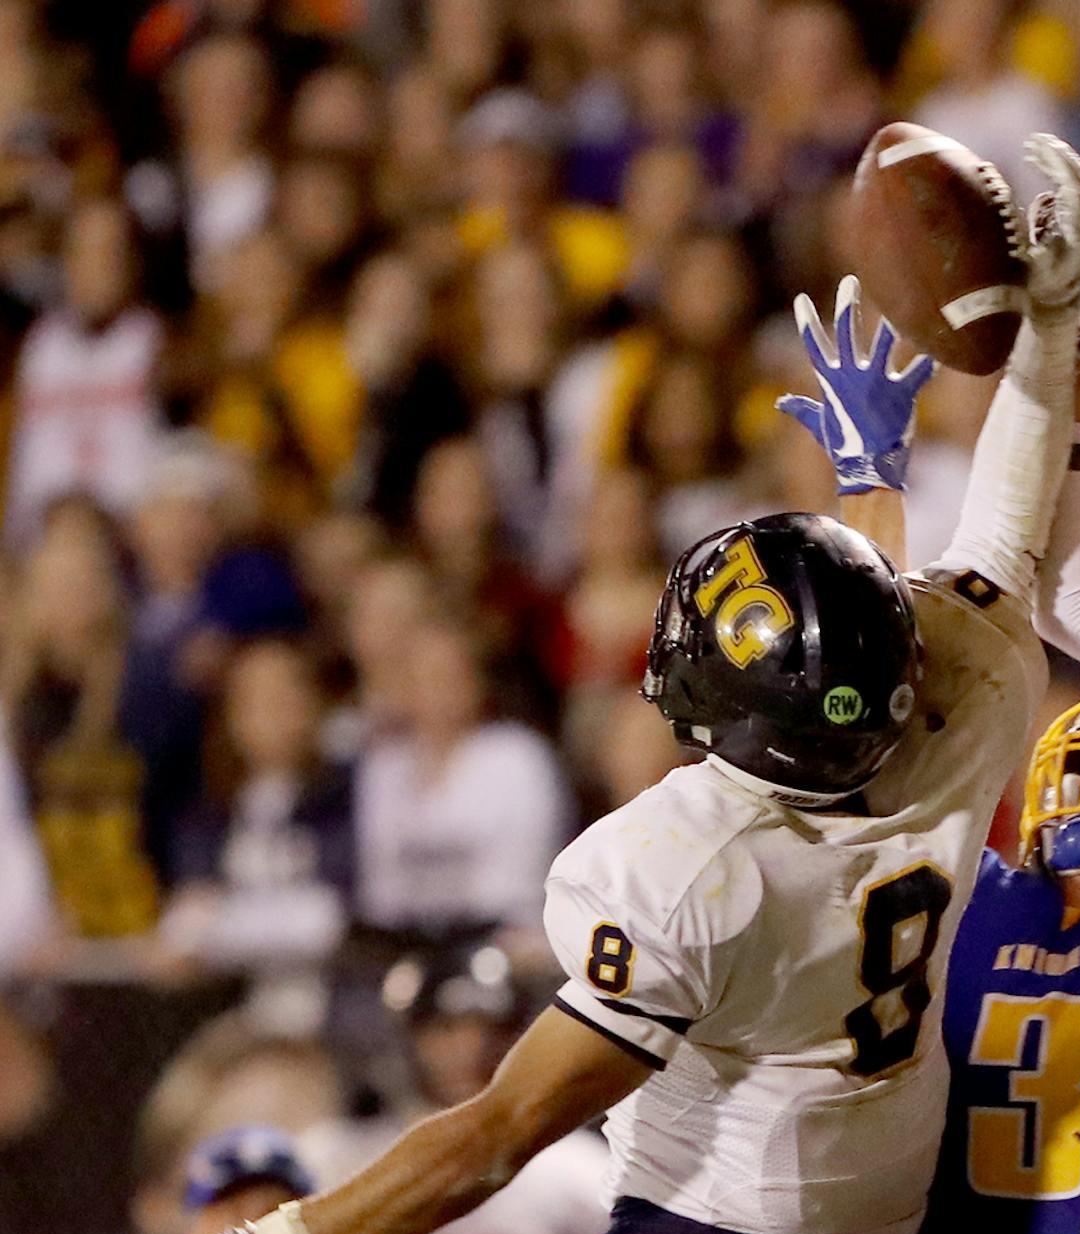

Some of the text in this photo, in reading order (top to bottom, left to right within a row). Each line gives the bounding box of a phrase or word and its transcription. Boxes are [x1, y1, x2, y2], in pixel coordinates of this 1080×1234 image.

[693, 535, 796, 671] TG
[827, 695, 859, 716] RW
[585, 920, 637, 998] 8
[844, 859, 955, 1084] 8
